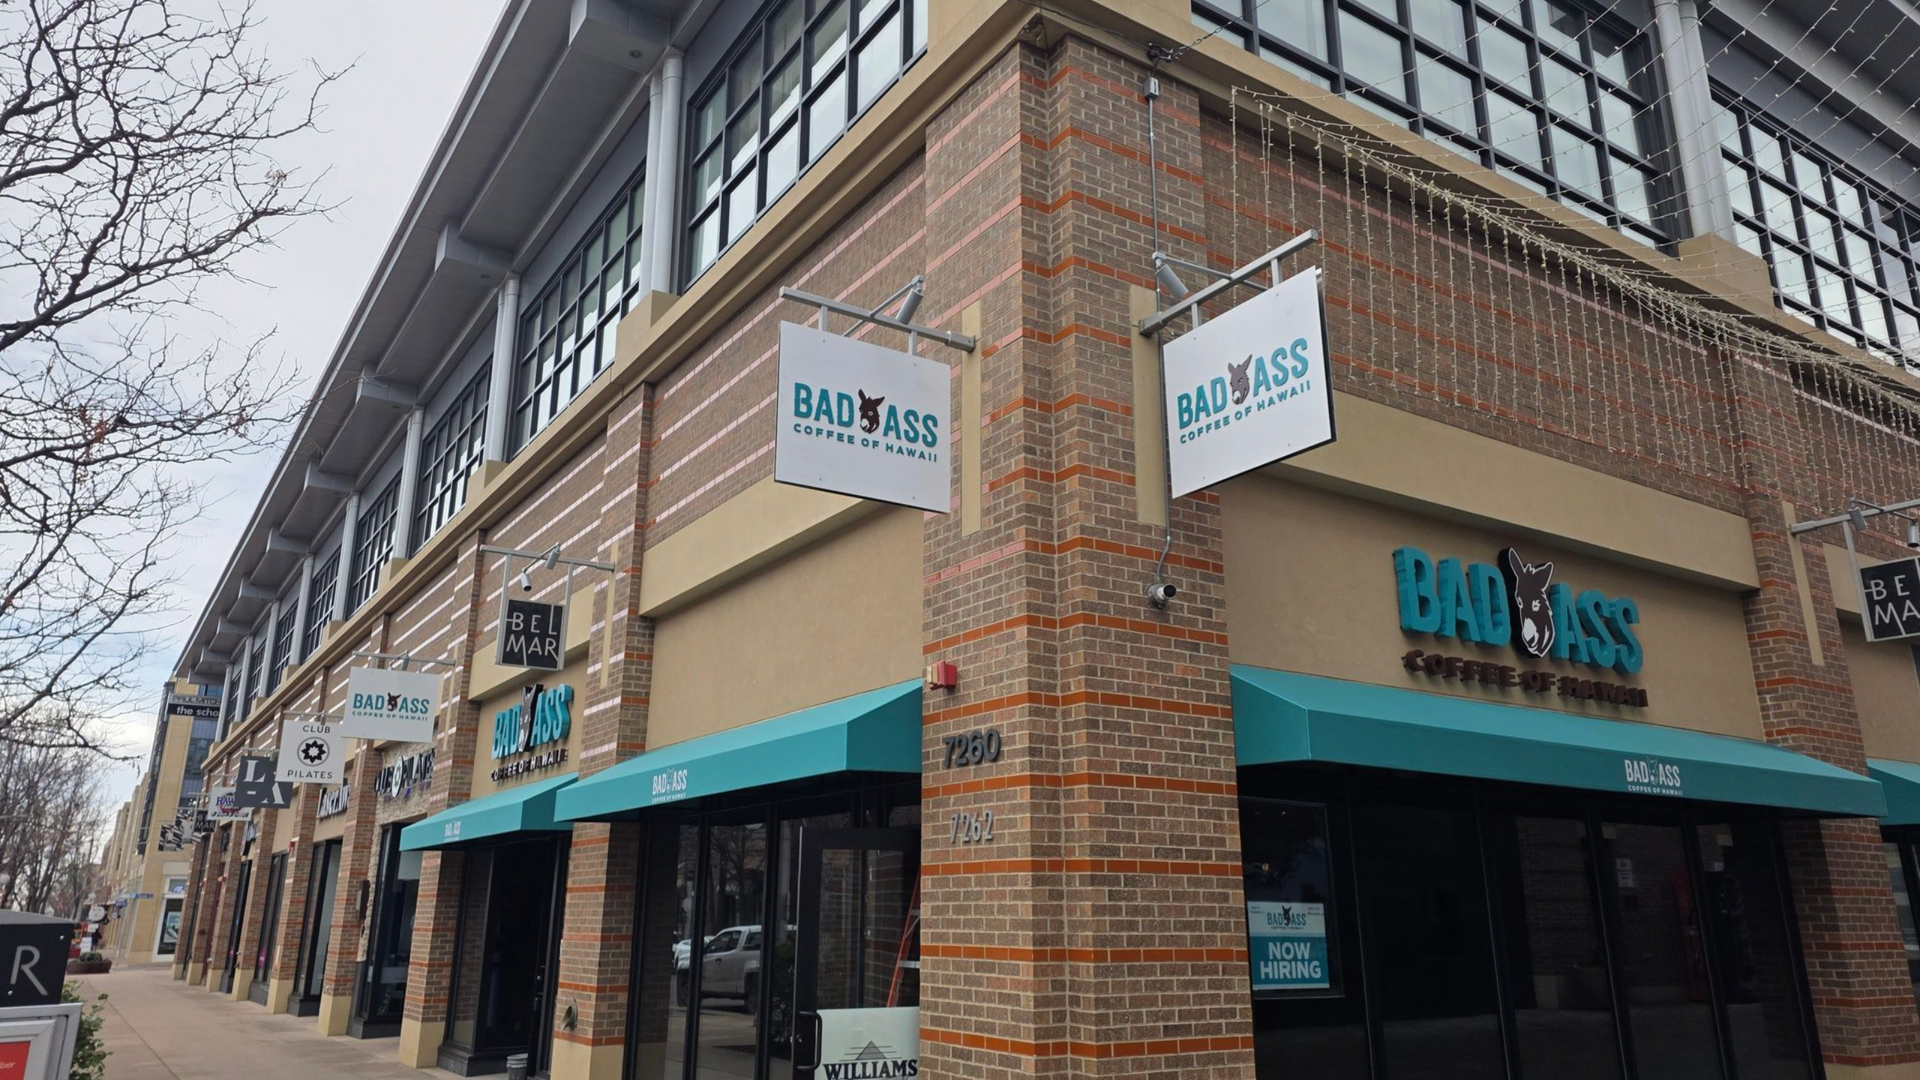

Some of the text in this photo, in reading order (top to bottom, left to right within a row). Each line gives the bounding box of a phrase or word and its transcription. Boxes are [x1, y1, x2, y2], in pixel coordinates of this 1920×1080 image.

[1177, 337, 1309, 430] BAD ASS
[793, 382, 938, 448] BAD ASS
[1180, 380, 1311, 444] COFFEE OF HAWAII
[793, 423, 937, 463] COFFEE OF HAWAII
[508, 606, 558, 636] BEL
[1393, 545, 1644, 675] BAD ASS
[506, 634, 558, 666] MAR
[1401, 649, 1648, 708] COFFEE OF HAWAII
[176, 705, 220, 717] the scho
[352, 693, 430, 714] BAD ASS
[302, 725, 331, 734] CLUB
[491, 684, 574, 760] BAD ASS
[942, 728, 1001, 768] 7260
[243, 760, 266, 783] L
[287, 770, 333, 779] PILATES
[652, 769, 688, 796] BAD ASS
[1624, 760, 1681, 787] BAD ASS
[951, 809, 994, 844] 7262
[1267, 912, 1307, 926] BAD ASS
[1268, 941, 1311, 960] NOW
[10, 945, 48, 996] R
[1260, 960, 1322, 979] HIRING
[822, 1059, 918, 1080] WILLIAMS
